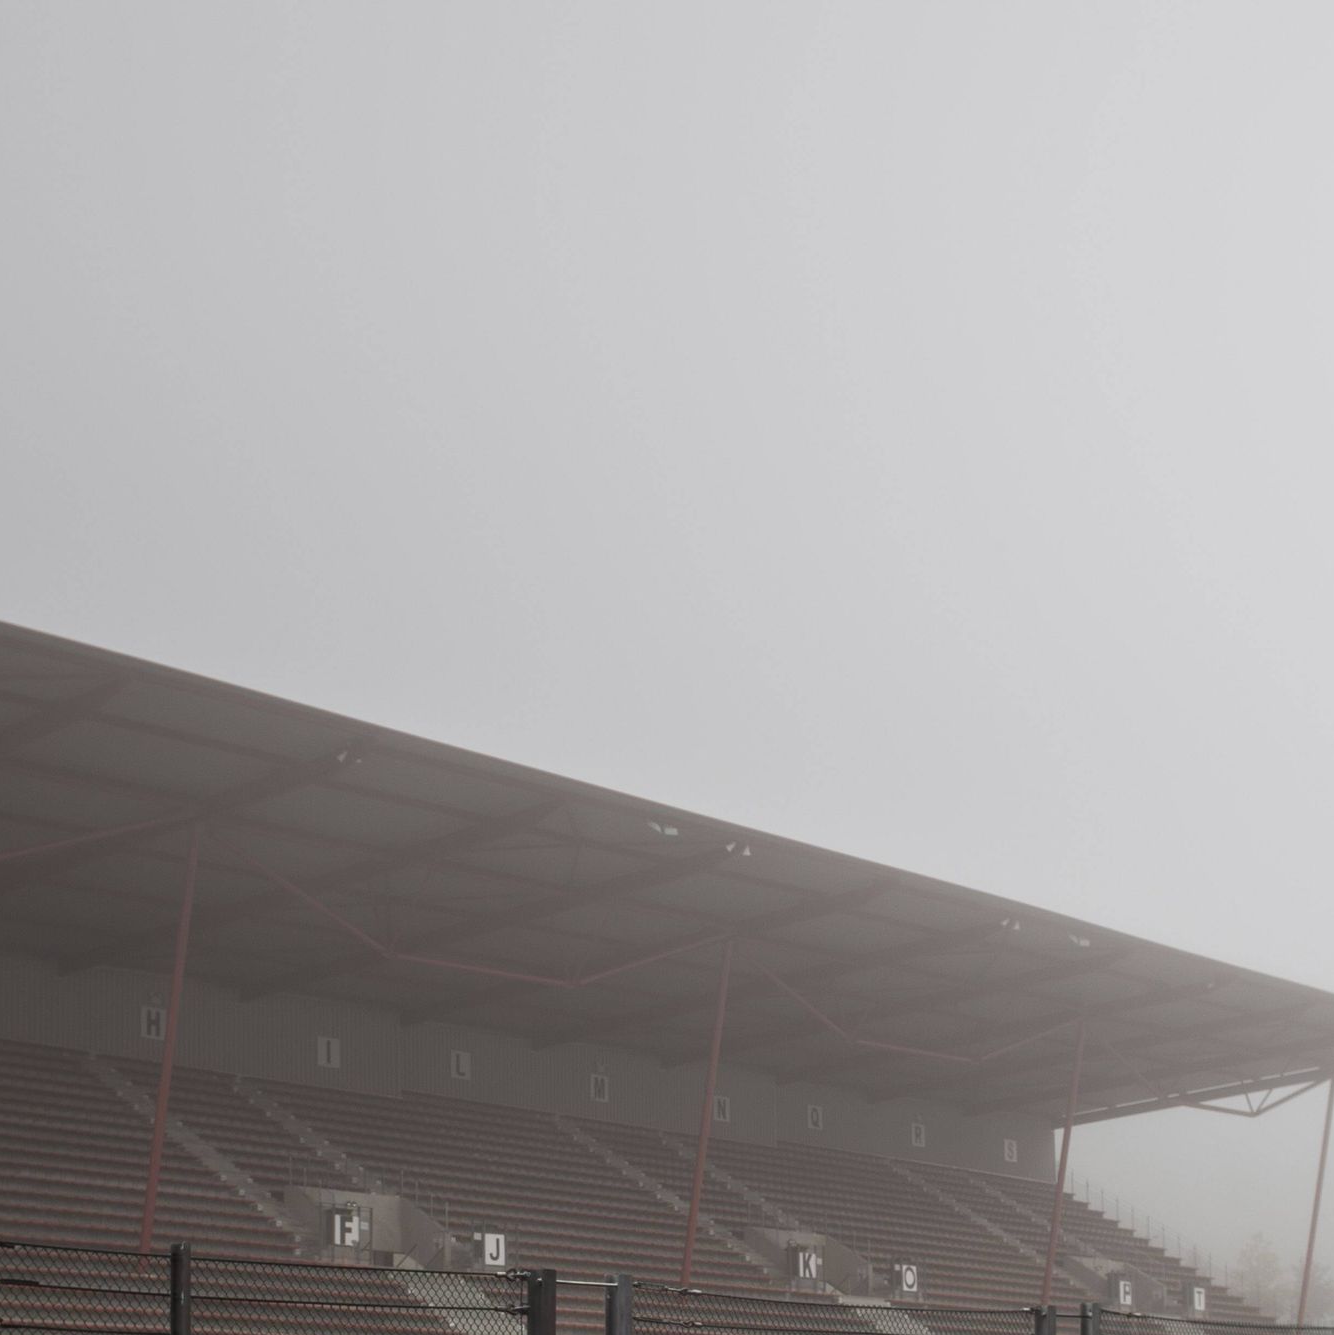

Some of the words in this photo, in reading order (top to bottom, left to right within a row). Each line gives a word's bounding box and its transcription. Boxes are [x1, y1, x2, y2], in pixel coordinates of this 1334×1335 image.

[146, 1009, 161, 1037] H
[456, 1053, 466, 1077] L
[594, 1077, 605, 1100] M
[717, 1098, 727, 1119] N
[810, 1107, 820, 1128] Q
[914, 1126, 922, 1145] R
[1007, 1142, 1015, 1160] S
[339, 1216, 354, 1246] F
[489, 1238, 500, 1261] J
[803, 1252, 814, 1278] K
[904, 1266, 916, 1290] O
[1122, 1283, 1131, 1302] P
[1195, 1290, 1204, 1309] T
